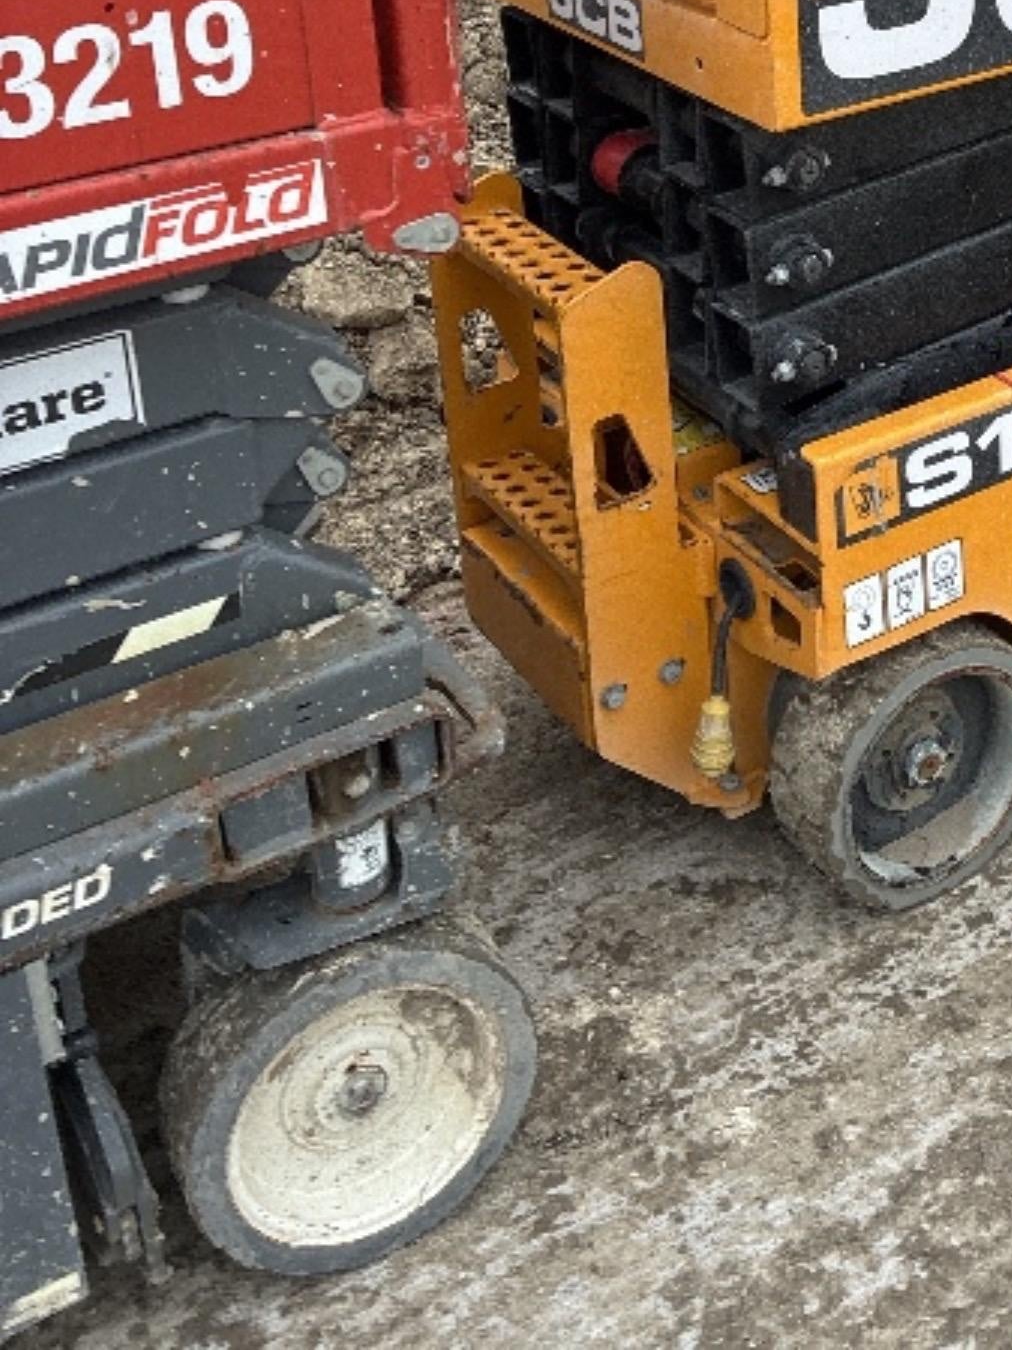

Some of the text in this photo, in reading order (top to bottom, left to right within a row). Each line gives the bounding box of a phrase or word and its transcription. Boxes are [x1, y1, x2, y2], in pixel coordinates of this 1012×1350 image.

[0, 0, 253, 139] 3219
[0, 380, 106, 438] are
[2, 863, 112, 940] DED
